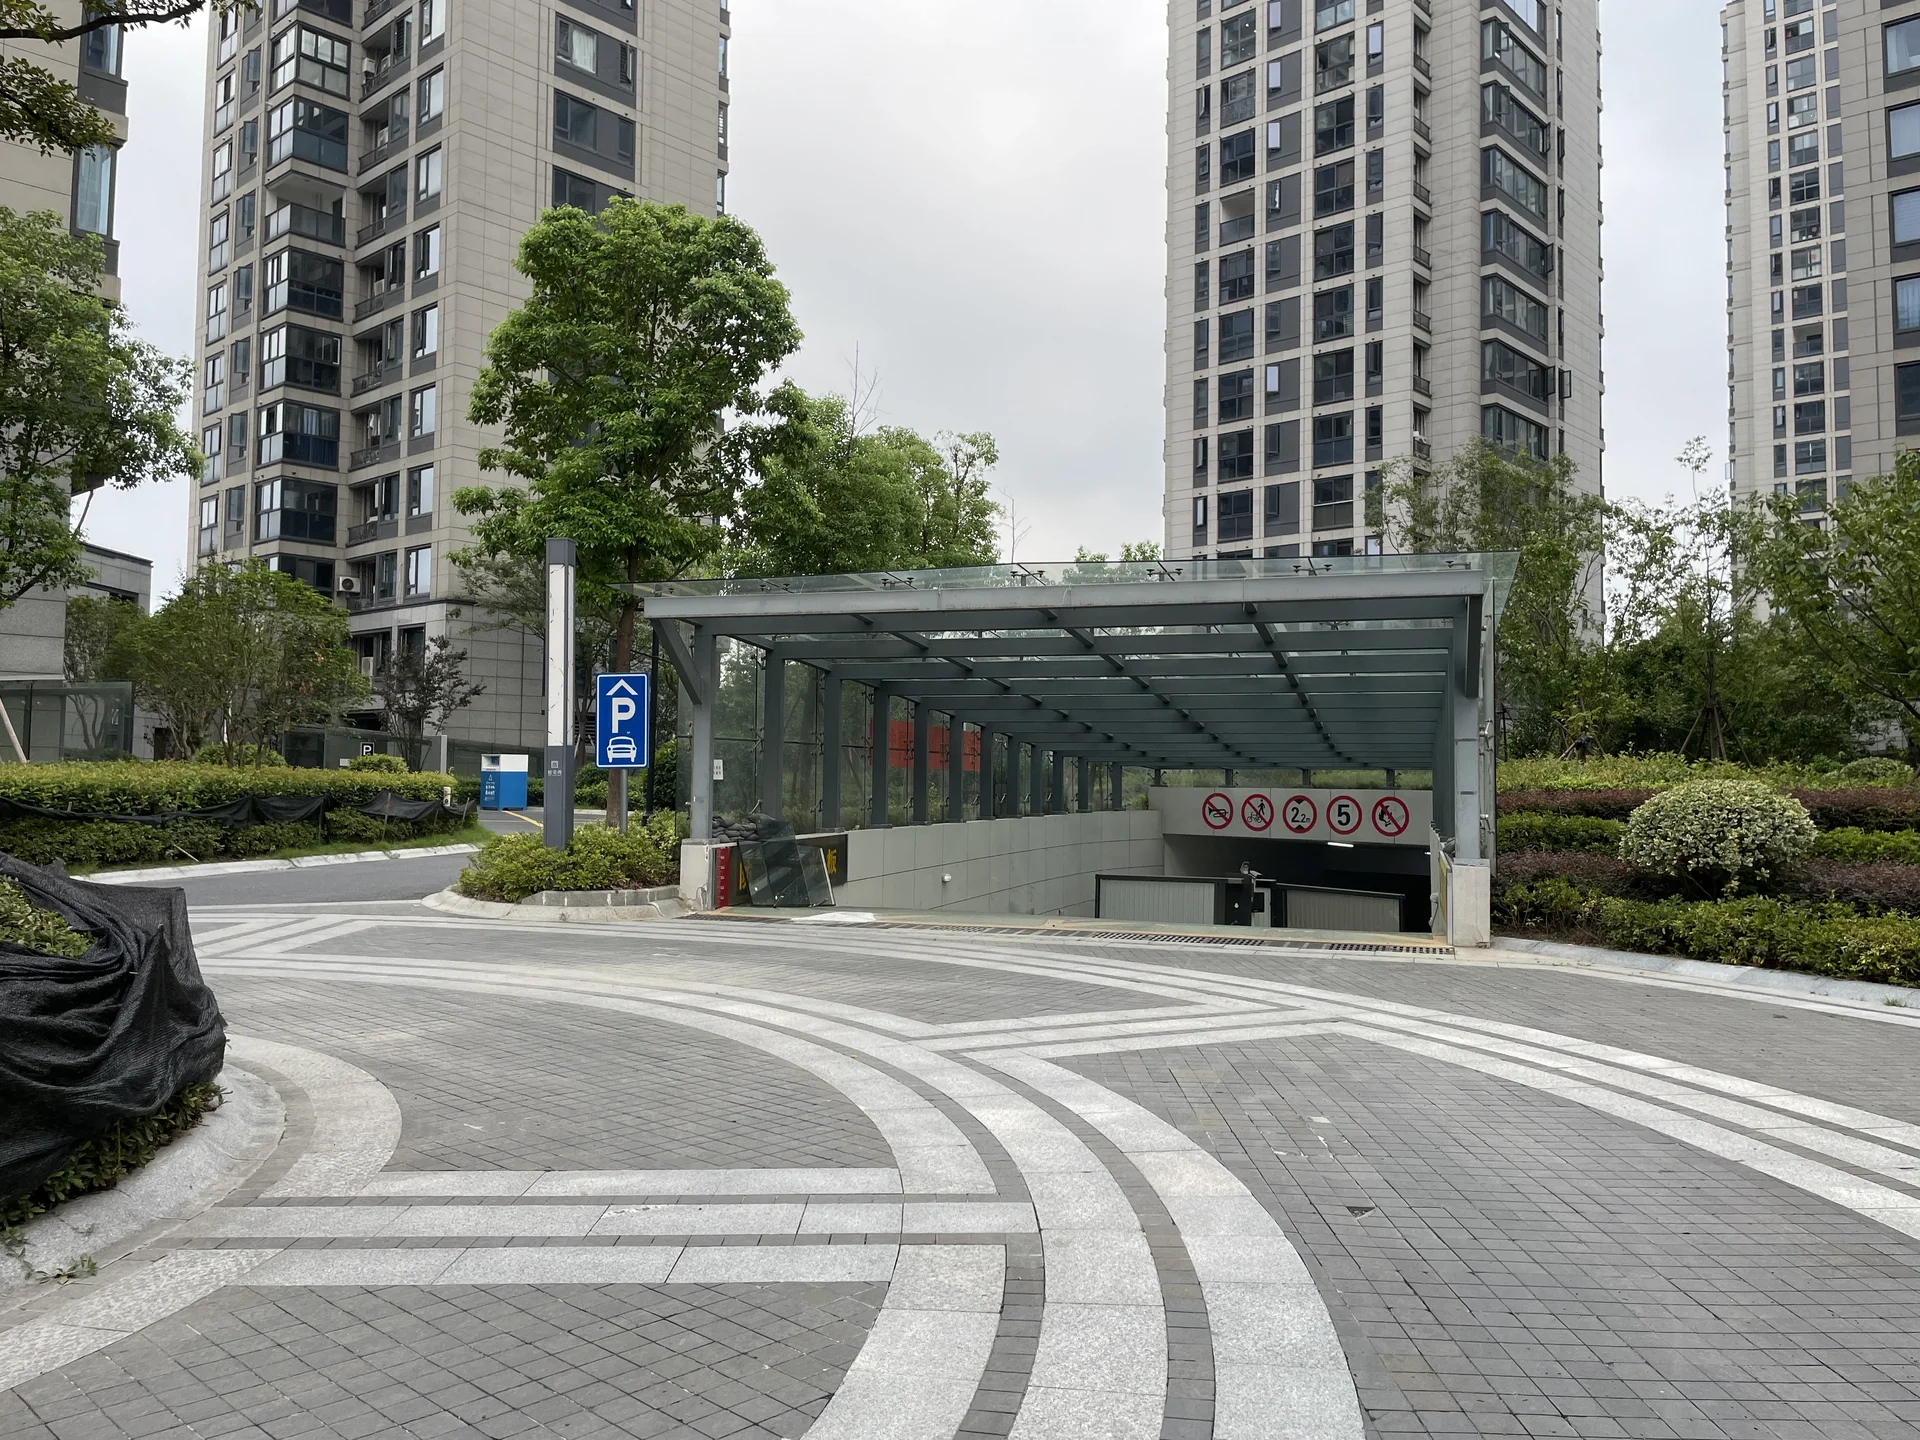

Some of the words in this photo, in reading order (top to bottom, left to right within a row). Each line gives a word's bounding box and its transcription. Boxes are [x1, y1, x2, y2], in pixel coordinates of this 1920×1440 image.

[612, 697, 636, 733] P
[363, 745, 372, 756] P
[1337, 804, 1351, 826] 5
